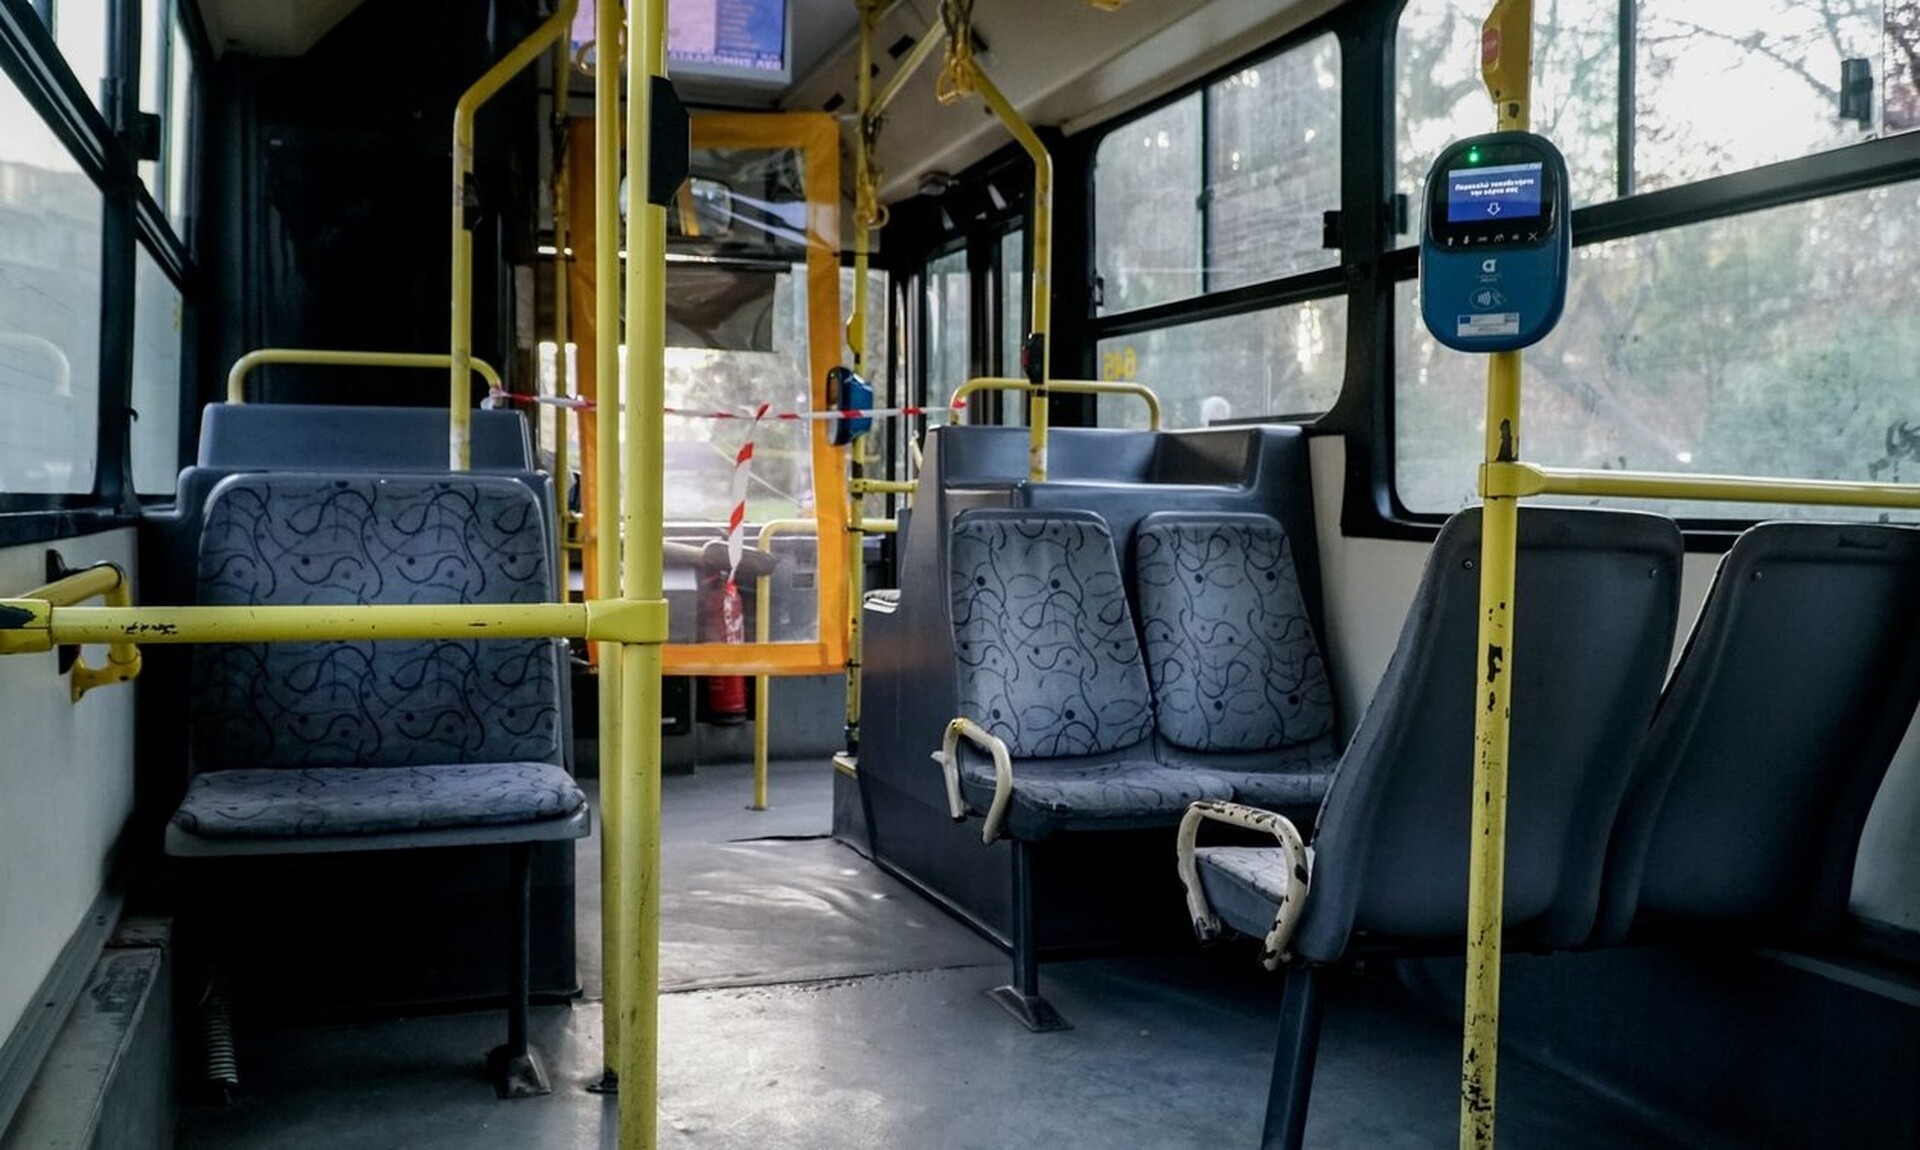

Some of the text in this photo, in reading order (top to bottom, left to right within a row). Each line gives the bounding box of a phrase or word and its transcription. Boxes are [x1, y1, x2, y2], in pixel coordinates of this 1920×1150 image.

[1455, 179, 1534, 191] Παρακαλώ τοποθετήστε
[1484, 188, 1504, 196] κάρτα
